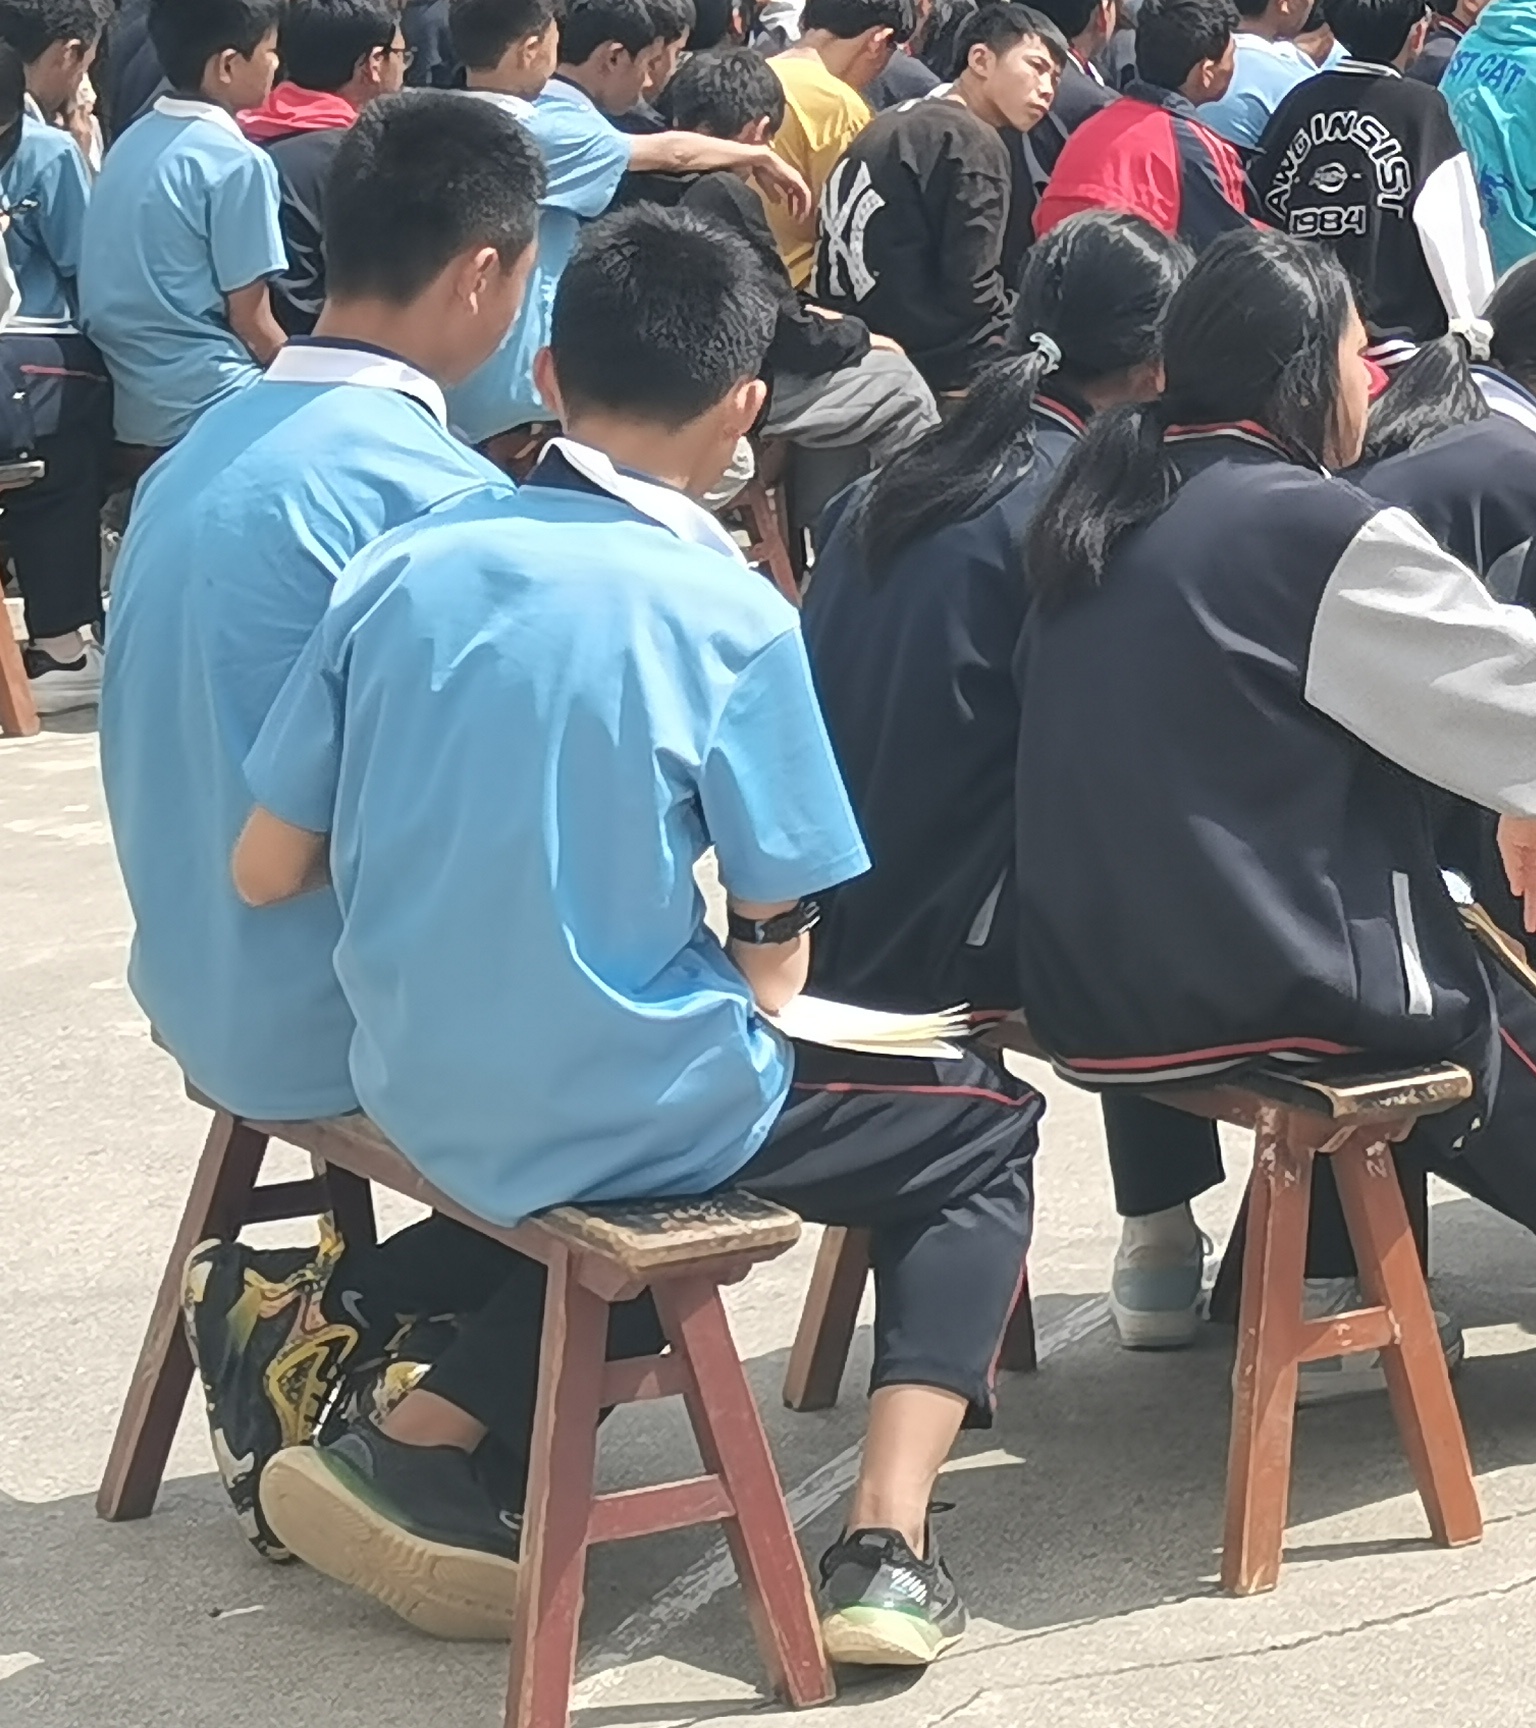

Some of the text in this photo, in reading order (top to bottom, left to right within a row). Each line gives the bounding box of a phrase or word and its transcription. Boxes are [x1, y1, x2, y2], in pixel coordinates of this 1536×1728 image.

[1449, 49, 1527, 96] ST CAT
[1288, 204, 1367, 239] 1984
